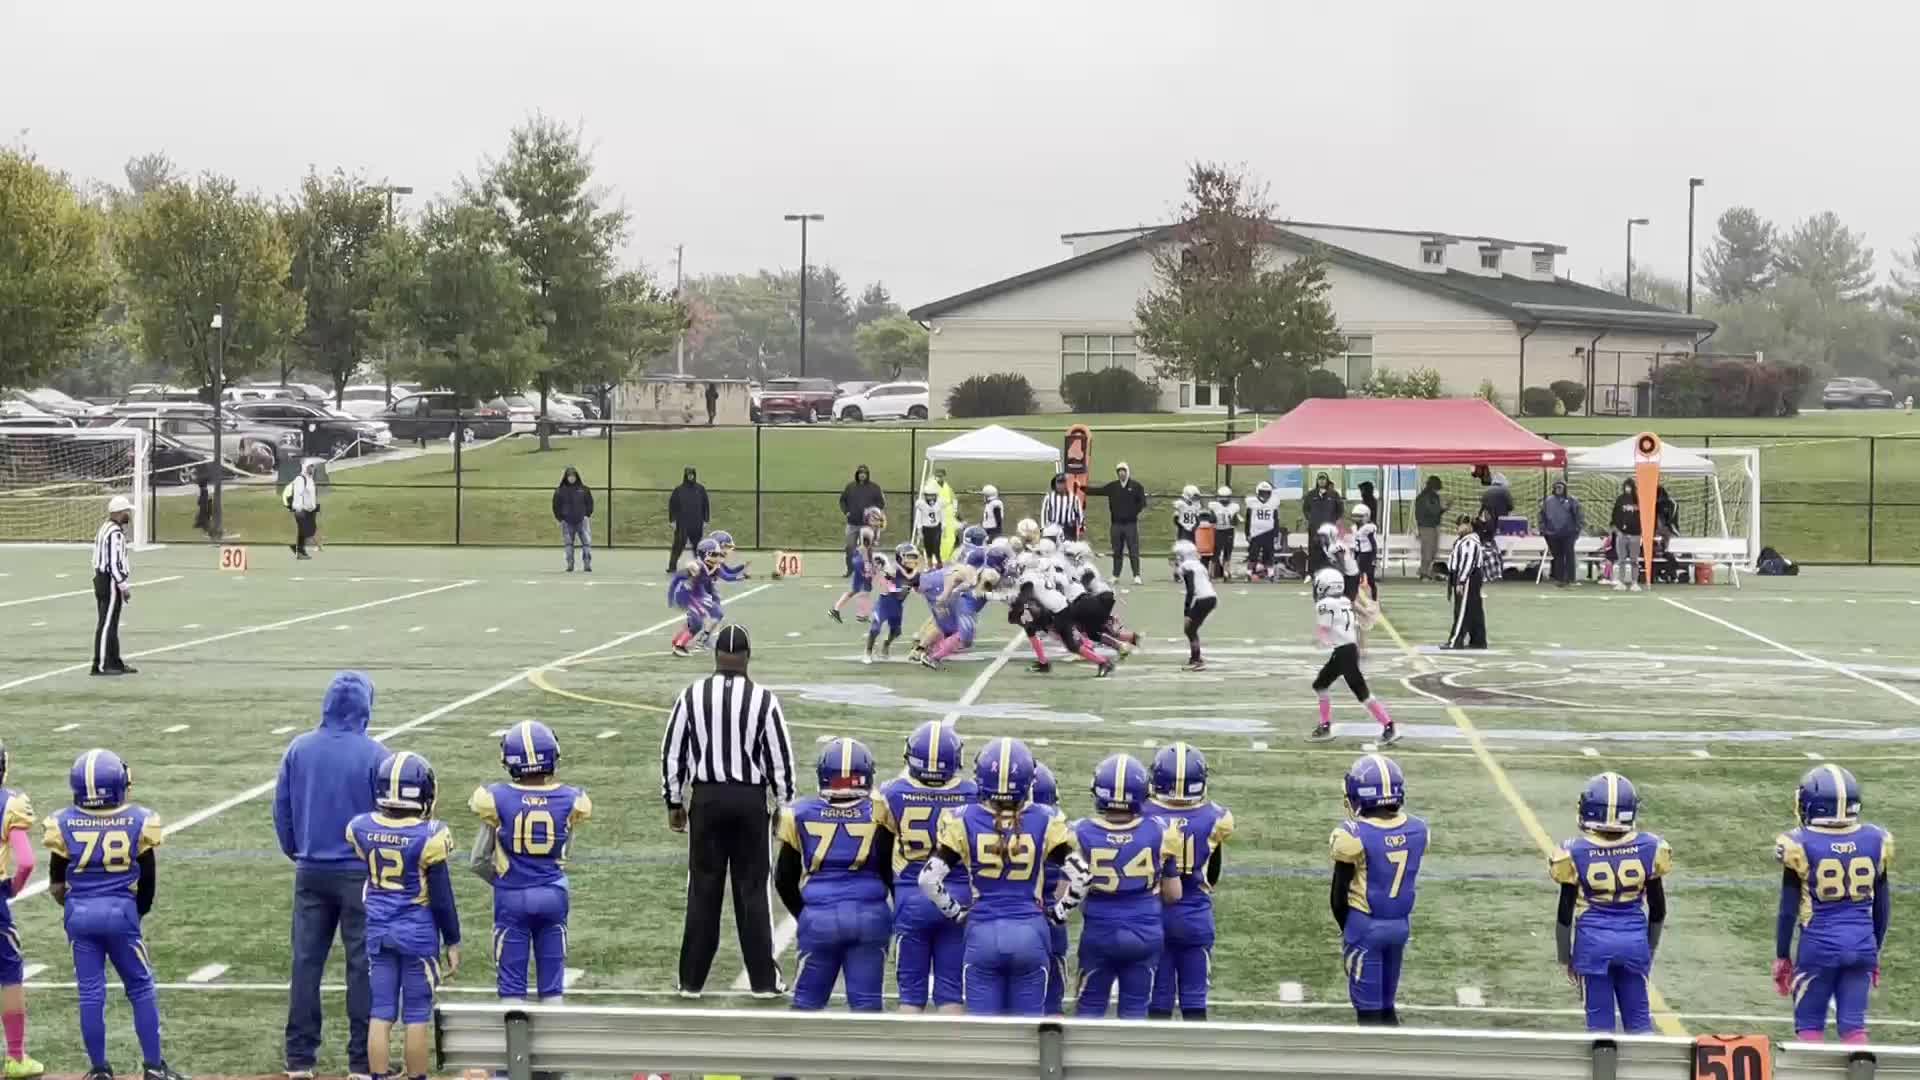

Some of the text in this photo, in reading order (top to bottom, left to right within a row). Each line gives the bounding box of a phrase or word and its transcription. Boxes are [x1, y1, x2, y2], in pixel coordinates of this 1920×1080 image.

[223, 549, 243, 568] 30
[779, 556, 799, 574] 40
[67, 817, 134, 828] RODRIGUEZ
[513, 810, 554, 855] 10
[820, 808, 862, 818] RAMOS
[73, 831, 131, 872] 78
[804, 823, 877, 871] 77
[977, 833, 1036, 880] 59
[1589, 846, 1639, 857] PUTMAN
[369, 848, 404, 889] 12
[1090, 847, 1154, 892] 54
[1386, 850, 1408, 898] 7
[1586, 858, 1646, 902] 99
[1816, 857, 1877, 902] 88
[1699, 1044, 1762, 1080] 50
